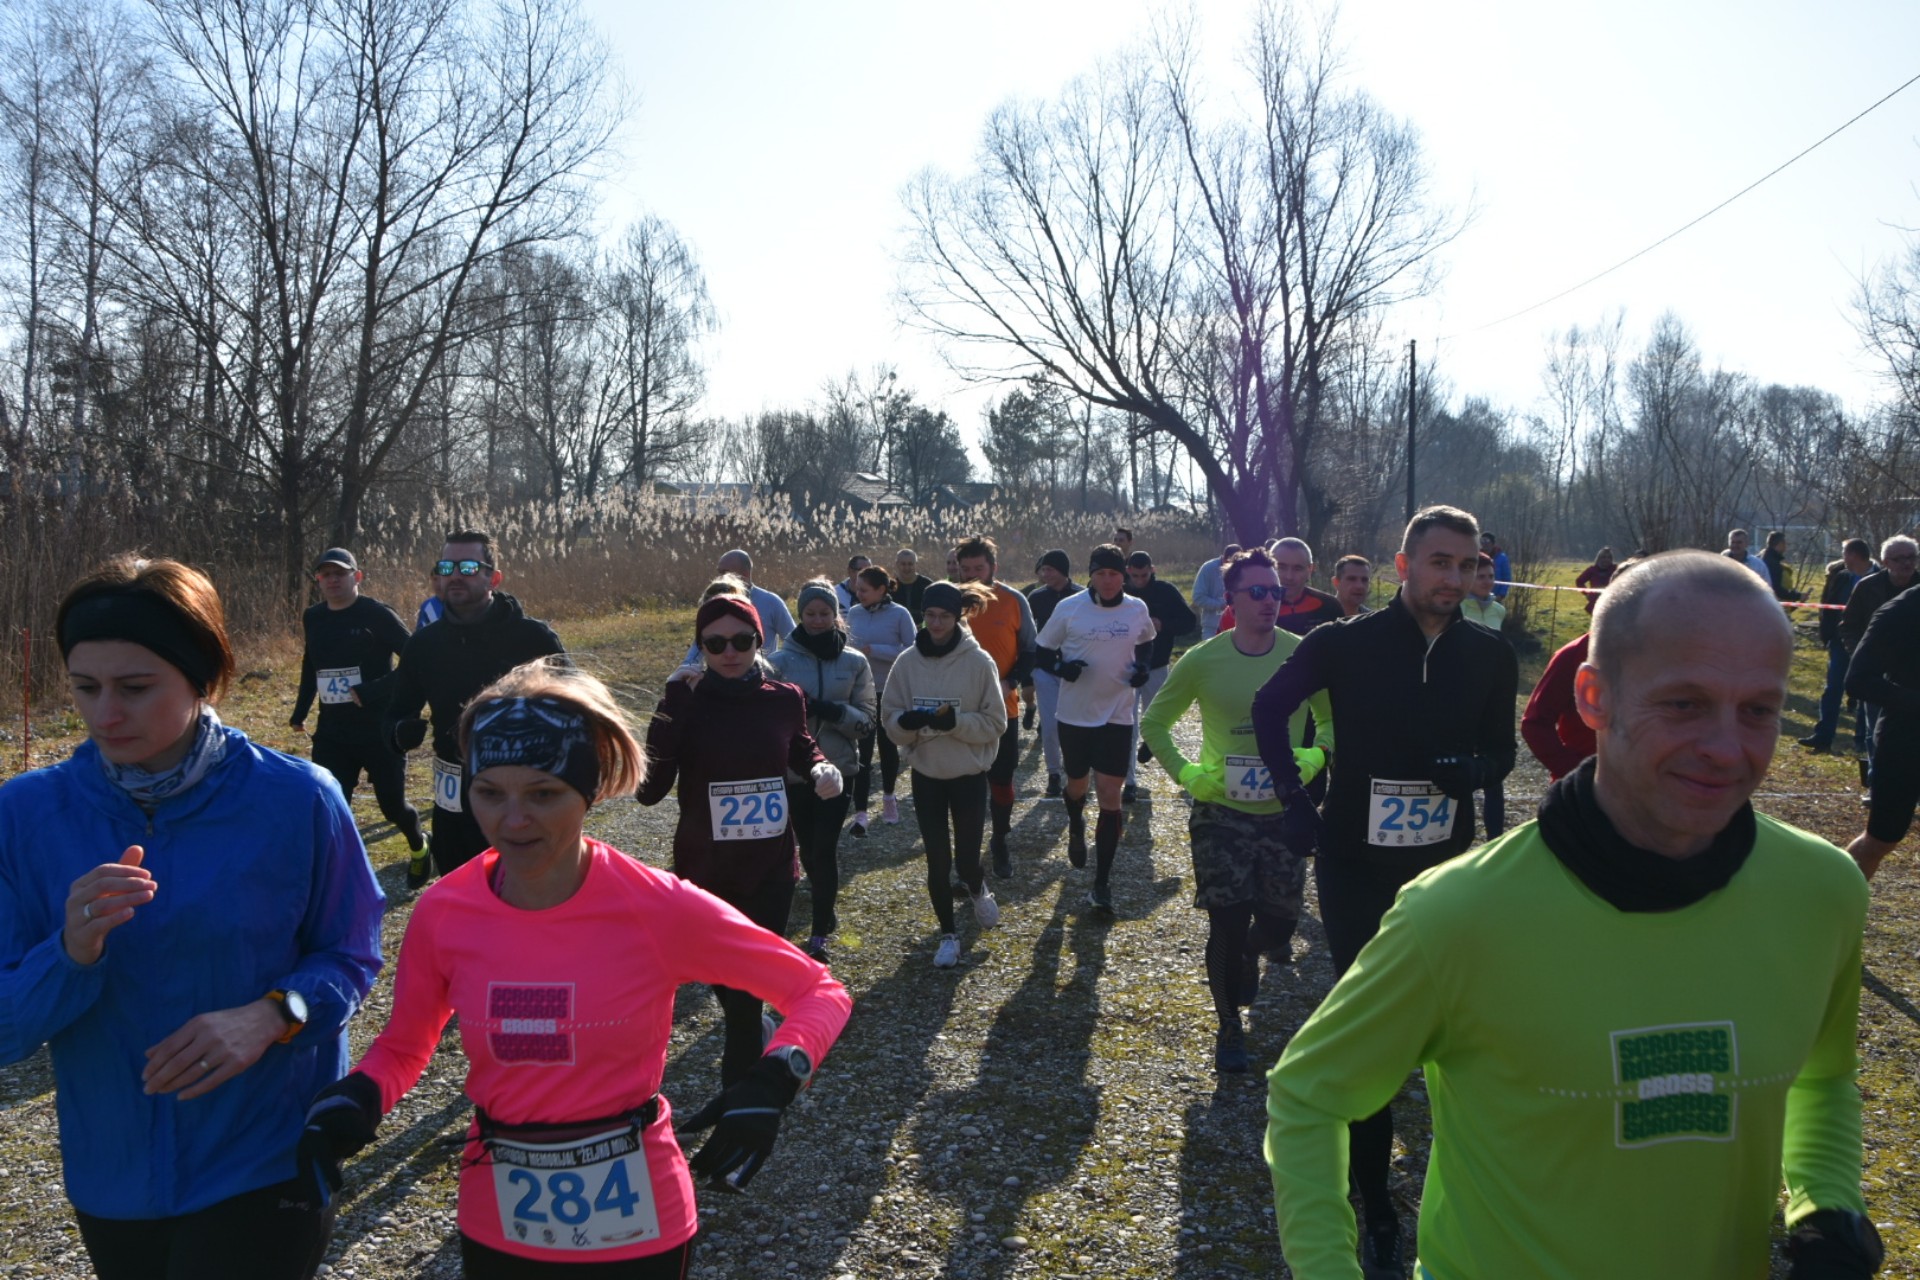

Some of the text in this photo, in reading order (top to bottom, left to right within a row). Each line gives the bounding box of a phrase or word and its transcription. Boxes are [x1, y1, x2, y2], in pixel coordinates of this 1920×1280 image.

[327, 677, 350, 695] 43
[1241, 767, 1275, 790] 42
[720, 792, 783, 826] 226
[1379, 795, 1450, 831] 254
[501, 1017, 557, 1034] CROSS
[1619, 1029, 1728, 1060] SCROSSC
[1621, 1051, 1730, 1082] ROSSROS
[1637, 1072, 1714, 1100] CROSS
[508, 1159, 640, 1226] 284
